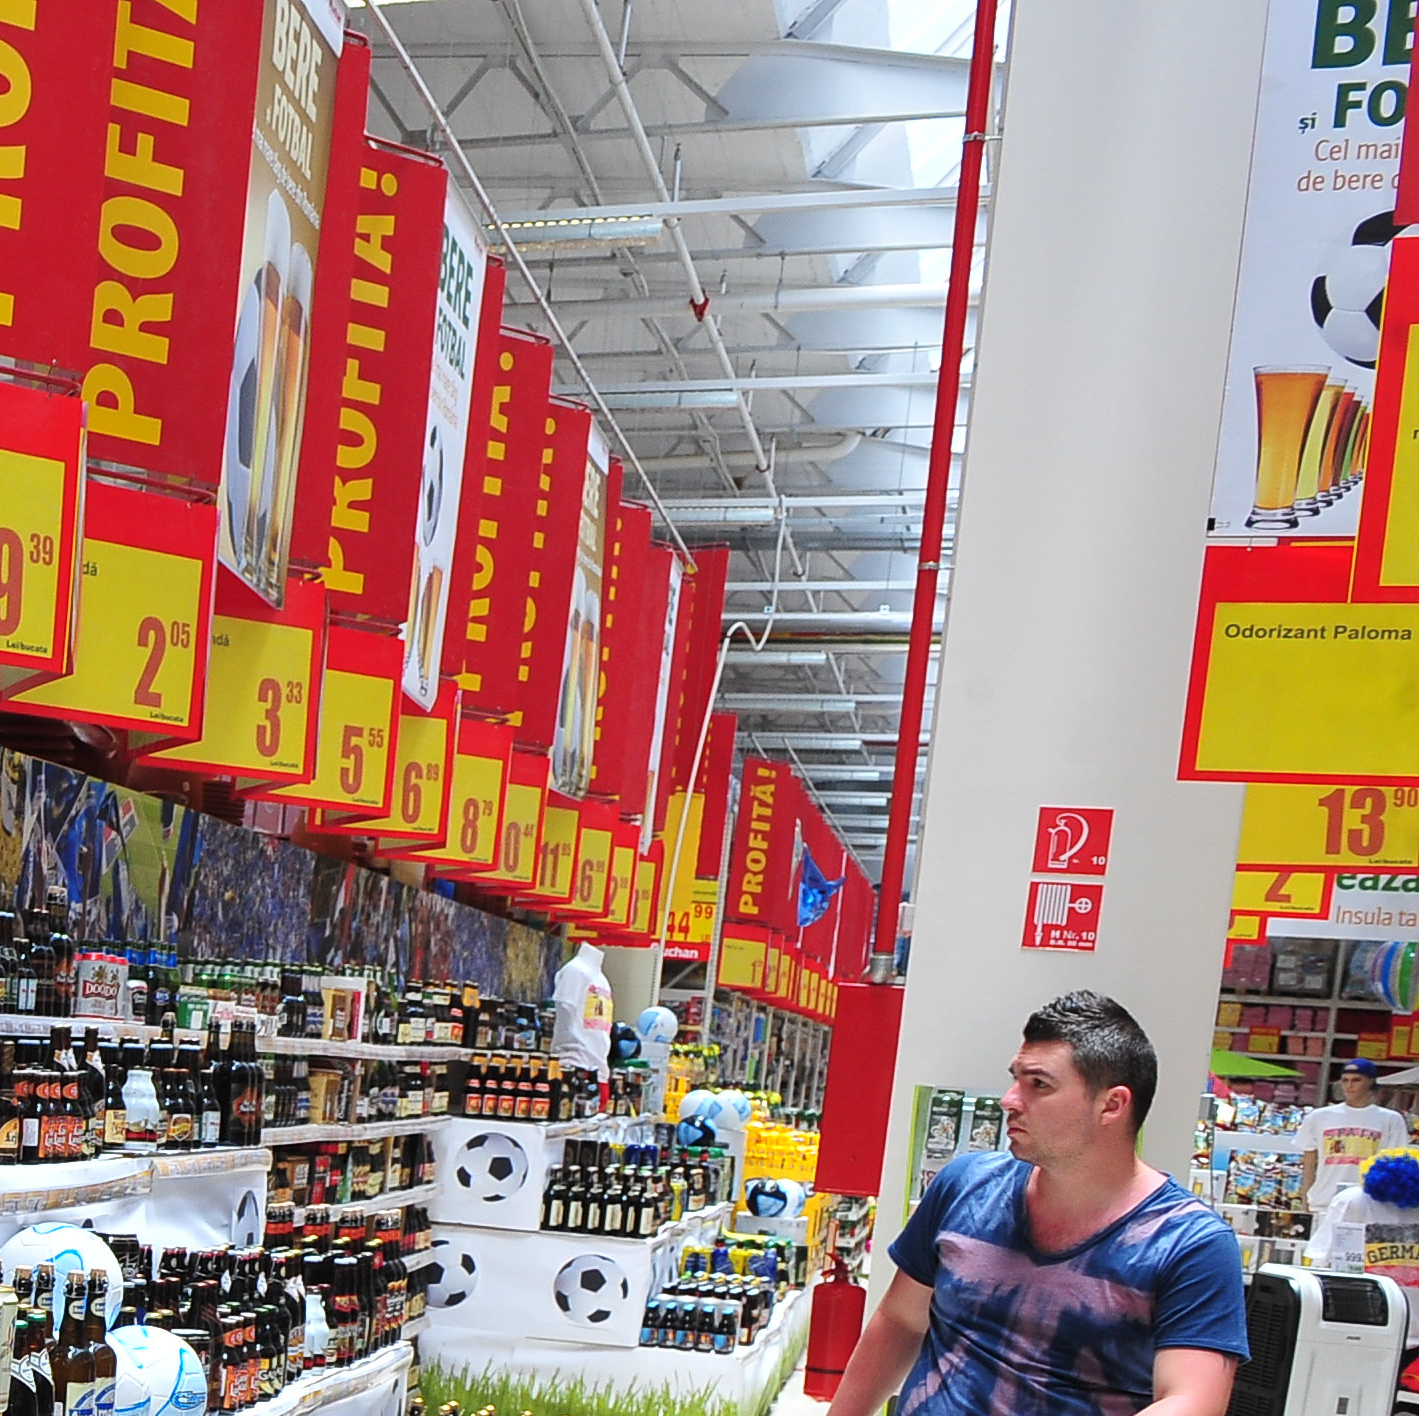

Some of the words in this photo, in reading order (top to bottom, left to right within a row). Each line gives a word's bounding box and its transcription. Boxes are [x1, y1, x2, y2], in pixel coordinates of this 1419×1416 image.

[272, 0, 322, 123] BERE
[271, 83, 312, 181] FOTBAL
[1298, 112, 1318, 134] și
[1315, 139, 1349, 162] Cel
[1356, 137, 1401, 161] mai
[1297, 170, 1325, 192] de
[1332, 169, 1383, 191] bere
[29, 533, 54, 566] 39
[6, 640, 48, 654] Lei/bucata
[1224, 623, 1327, 640] Odorizant
[1333, 625, 1413, 641] Paloma
[133, 616, 167, 708] 2
[171, 620, 190, 649] 05
[256, 678, 281, 757] 3
[286, 681, 302, 704] 33
[340, 725, 364, 794] 5
[368, 728, 384, 748] 55
[401, 762, 423, 823] 6
[426, 763, 439, 780] 89
[461, 797, 479, 854] 8
[1318, 787, 1387, 857] 13
[1393, 788, 1418, 808] 90
[1092, 856, 1106, 865] 10
[1336, 905, 1391, 926] Insula
